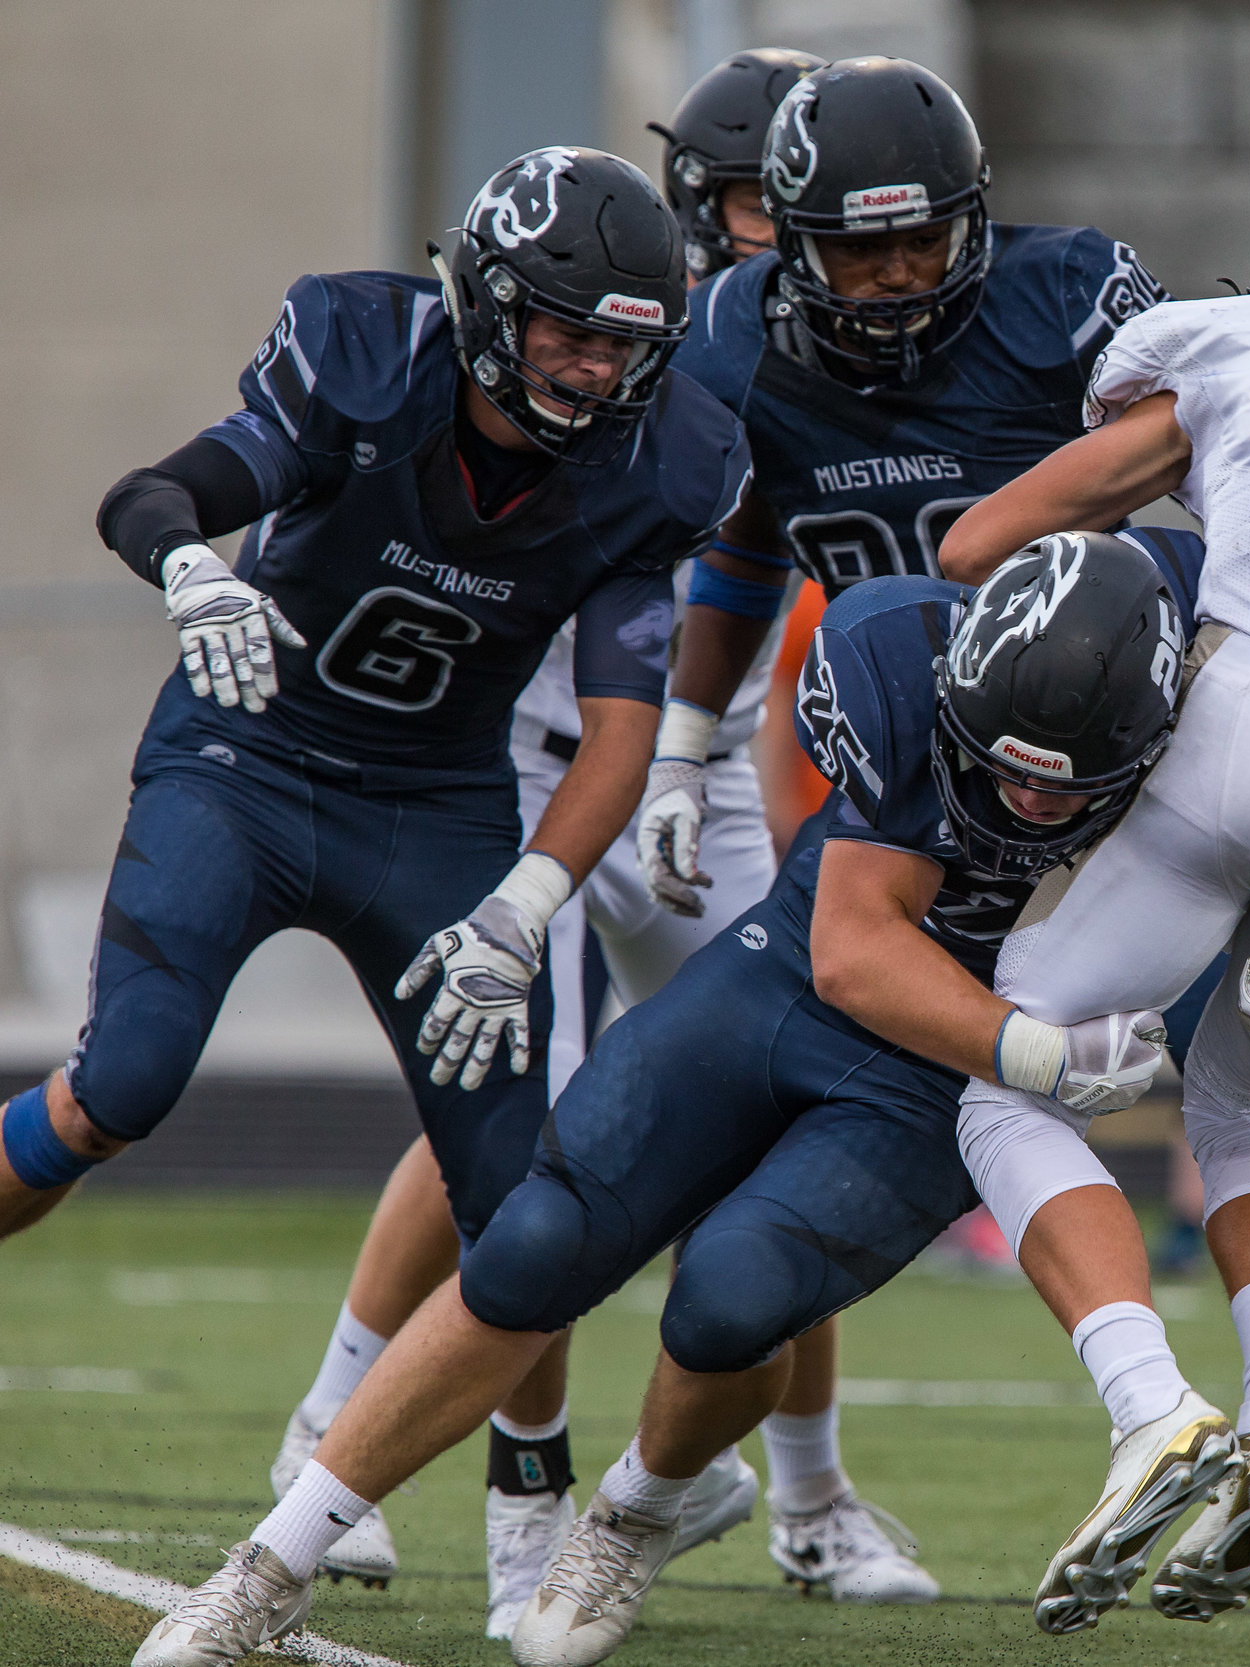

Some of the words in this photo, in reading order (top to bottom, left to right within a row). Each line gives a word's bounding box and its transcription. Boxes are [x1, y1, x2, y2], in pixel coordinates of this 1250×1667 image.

[862, 189, 908, 207] Riddell
[813, 454, 963, 494] MUSTANGS
[379, 539, 516, 602] MUSTANGS
[315, 585, 483, 712] 6
[797, 660, 871, 790] 25
